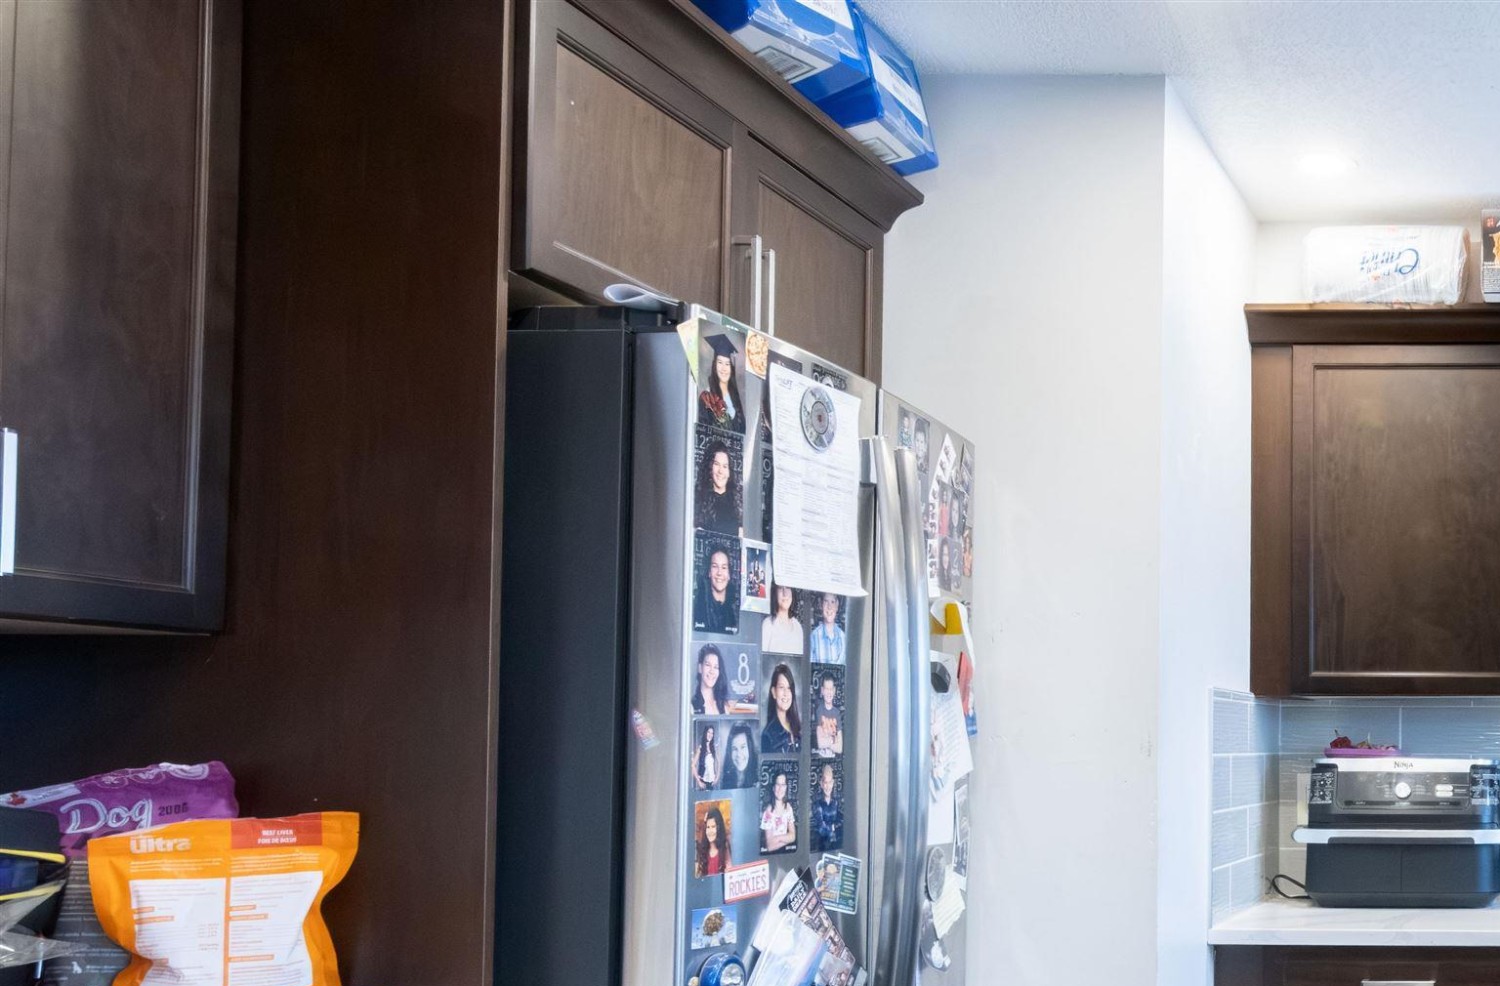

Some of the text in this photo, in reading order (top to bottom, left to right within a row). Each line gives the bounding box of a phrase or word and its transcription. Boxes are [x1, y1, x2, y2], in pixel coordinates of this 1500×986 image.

[738, 653, 749, 685] 8
[60, 798, 153, 834] Dog
[728, 874, 768, 899] ROCKIES
